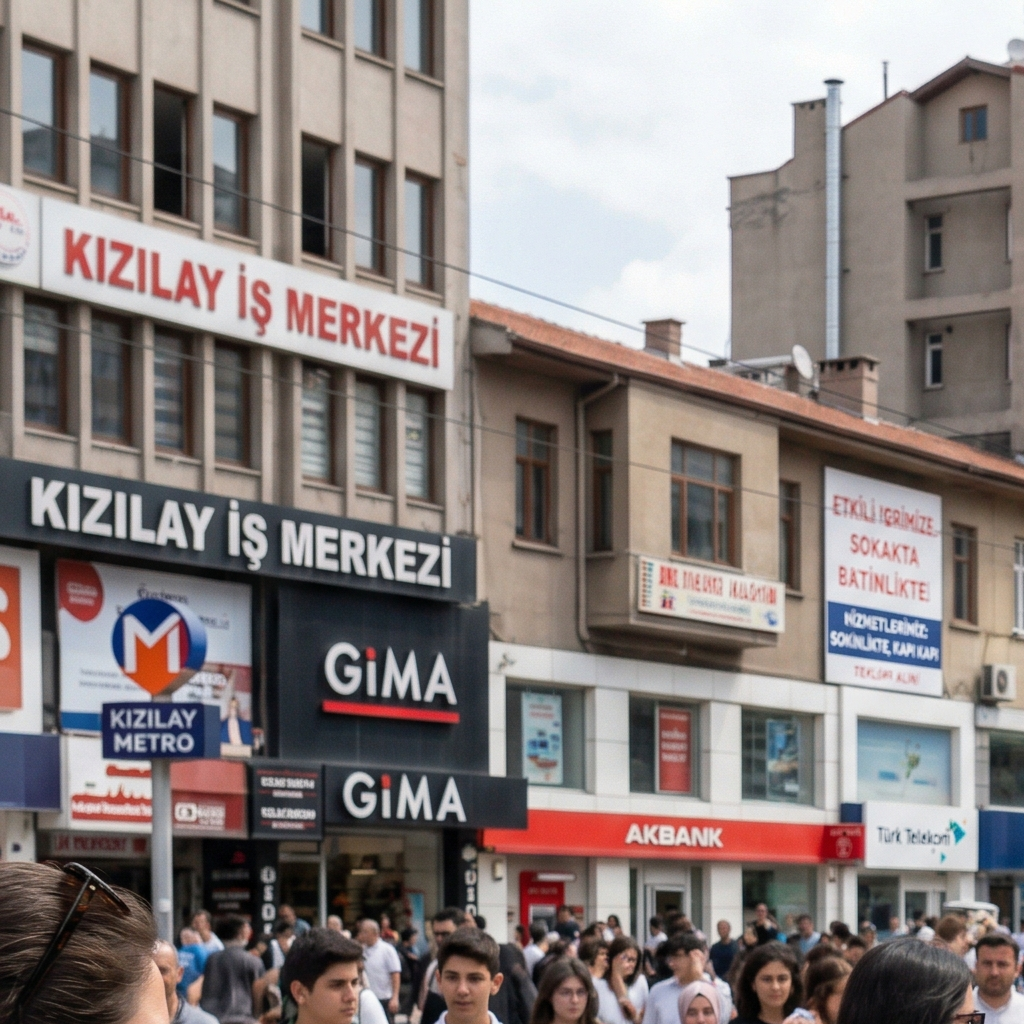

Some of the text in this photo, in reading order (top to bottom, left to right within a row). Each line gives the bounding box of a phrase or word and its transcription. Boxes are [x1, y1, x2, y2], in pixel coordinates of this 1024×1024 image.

[63, 227, 441, 368] KIZILAY İŞ MERKEZİ
[30, 477, 453, 589] KIZILAY İŞ MERKEZİ
[850, 534, 920, 567] SOKAKTA
[110, 708, 198, 729] KIZILAY
[113, 733, 195, 753] METRO
[625, 823, 723, 848] AKBANK
[877, 826, 902, 845] Türk
